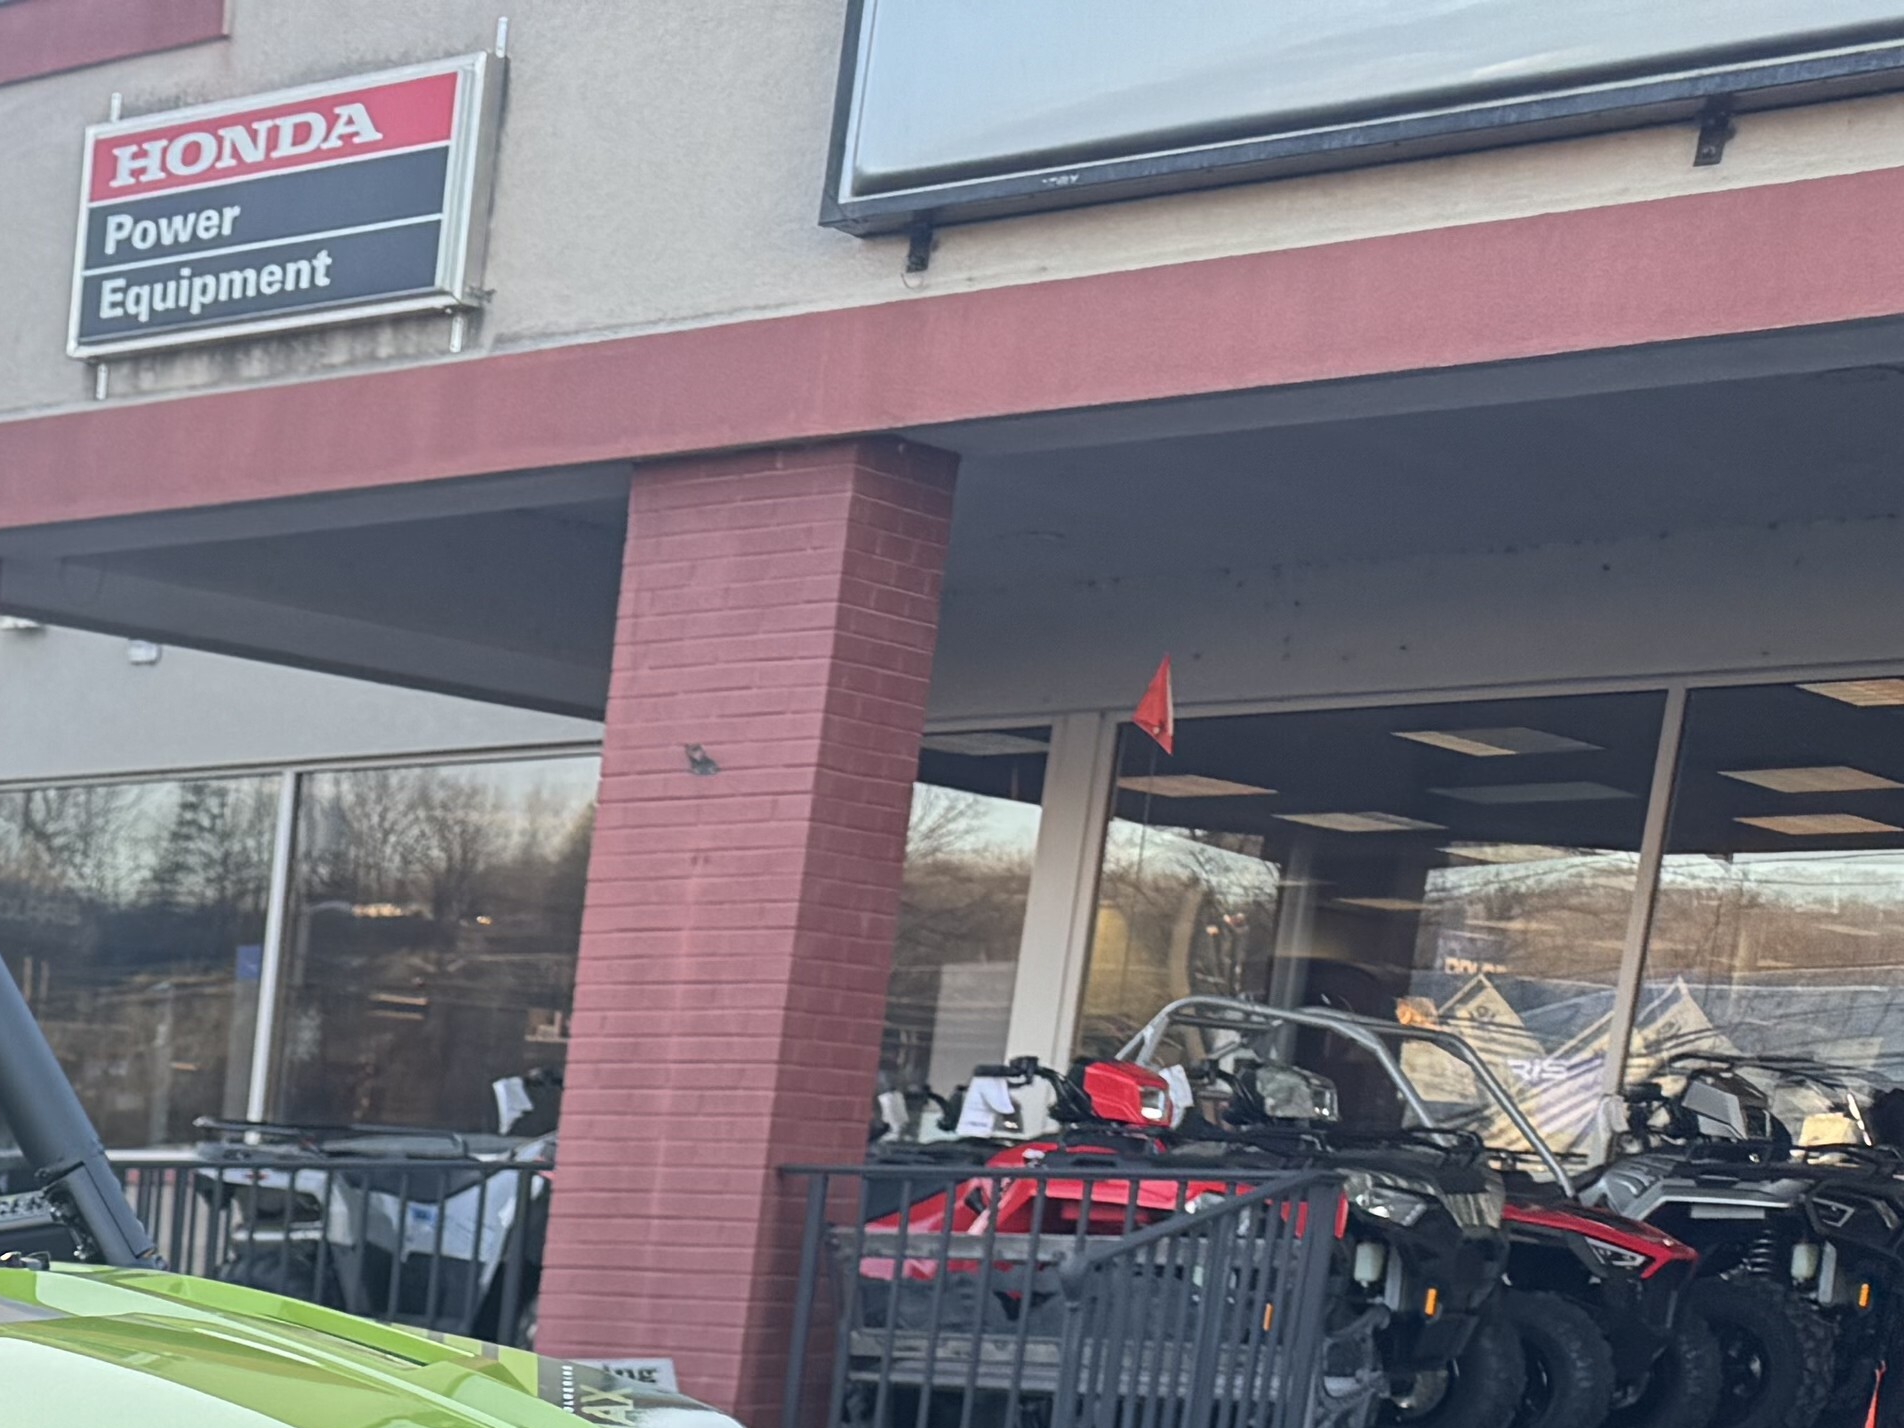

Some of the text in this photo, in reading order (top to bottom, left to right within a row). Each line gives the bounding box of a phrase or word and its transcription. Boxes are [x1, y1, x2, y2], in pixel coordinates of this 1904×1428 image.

[109, 102, 382, 188] HONDA
[104, 204, 241, 255] Power
[99, 250, 332, 322] Equipment
